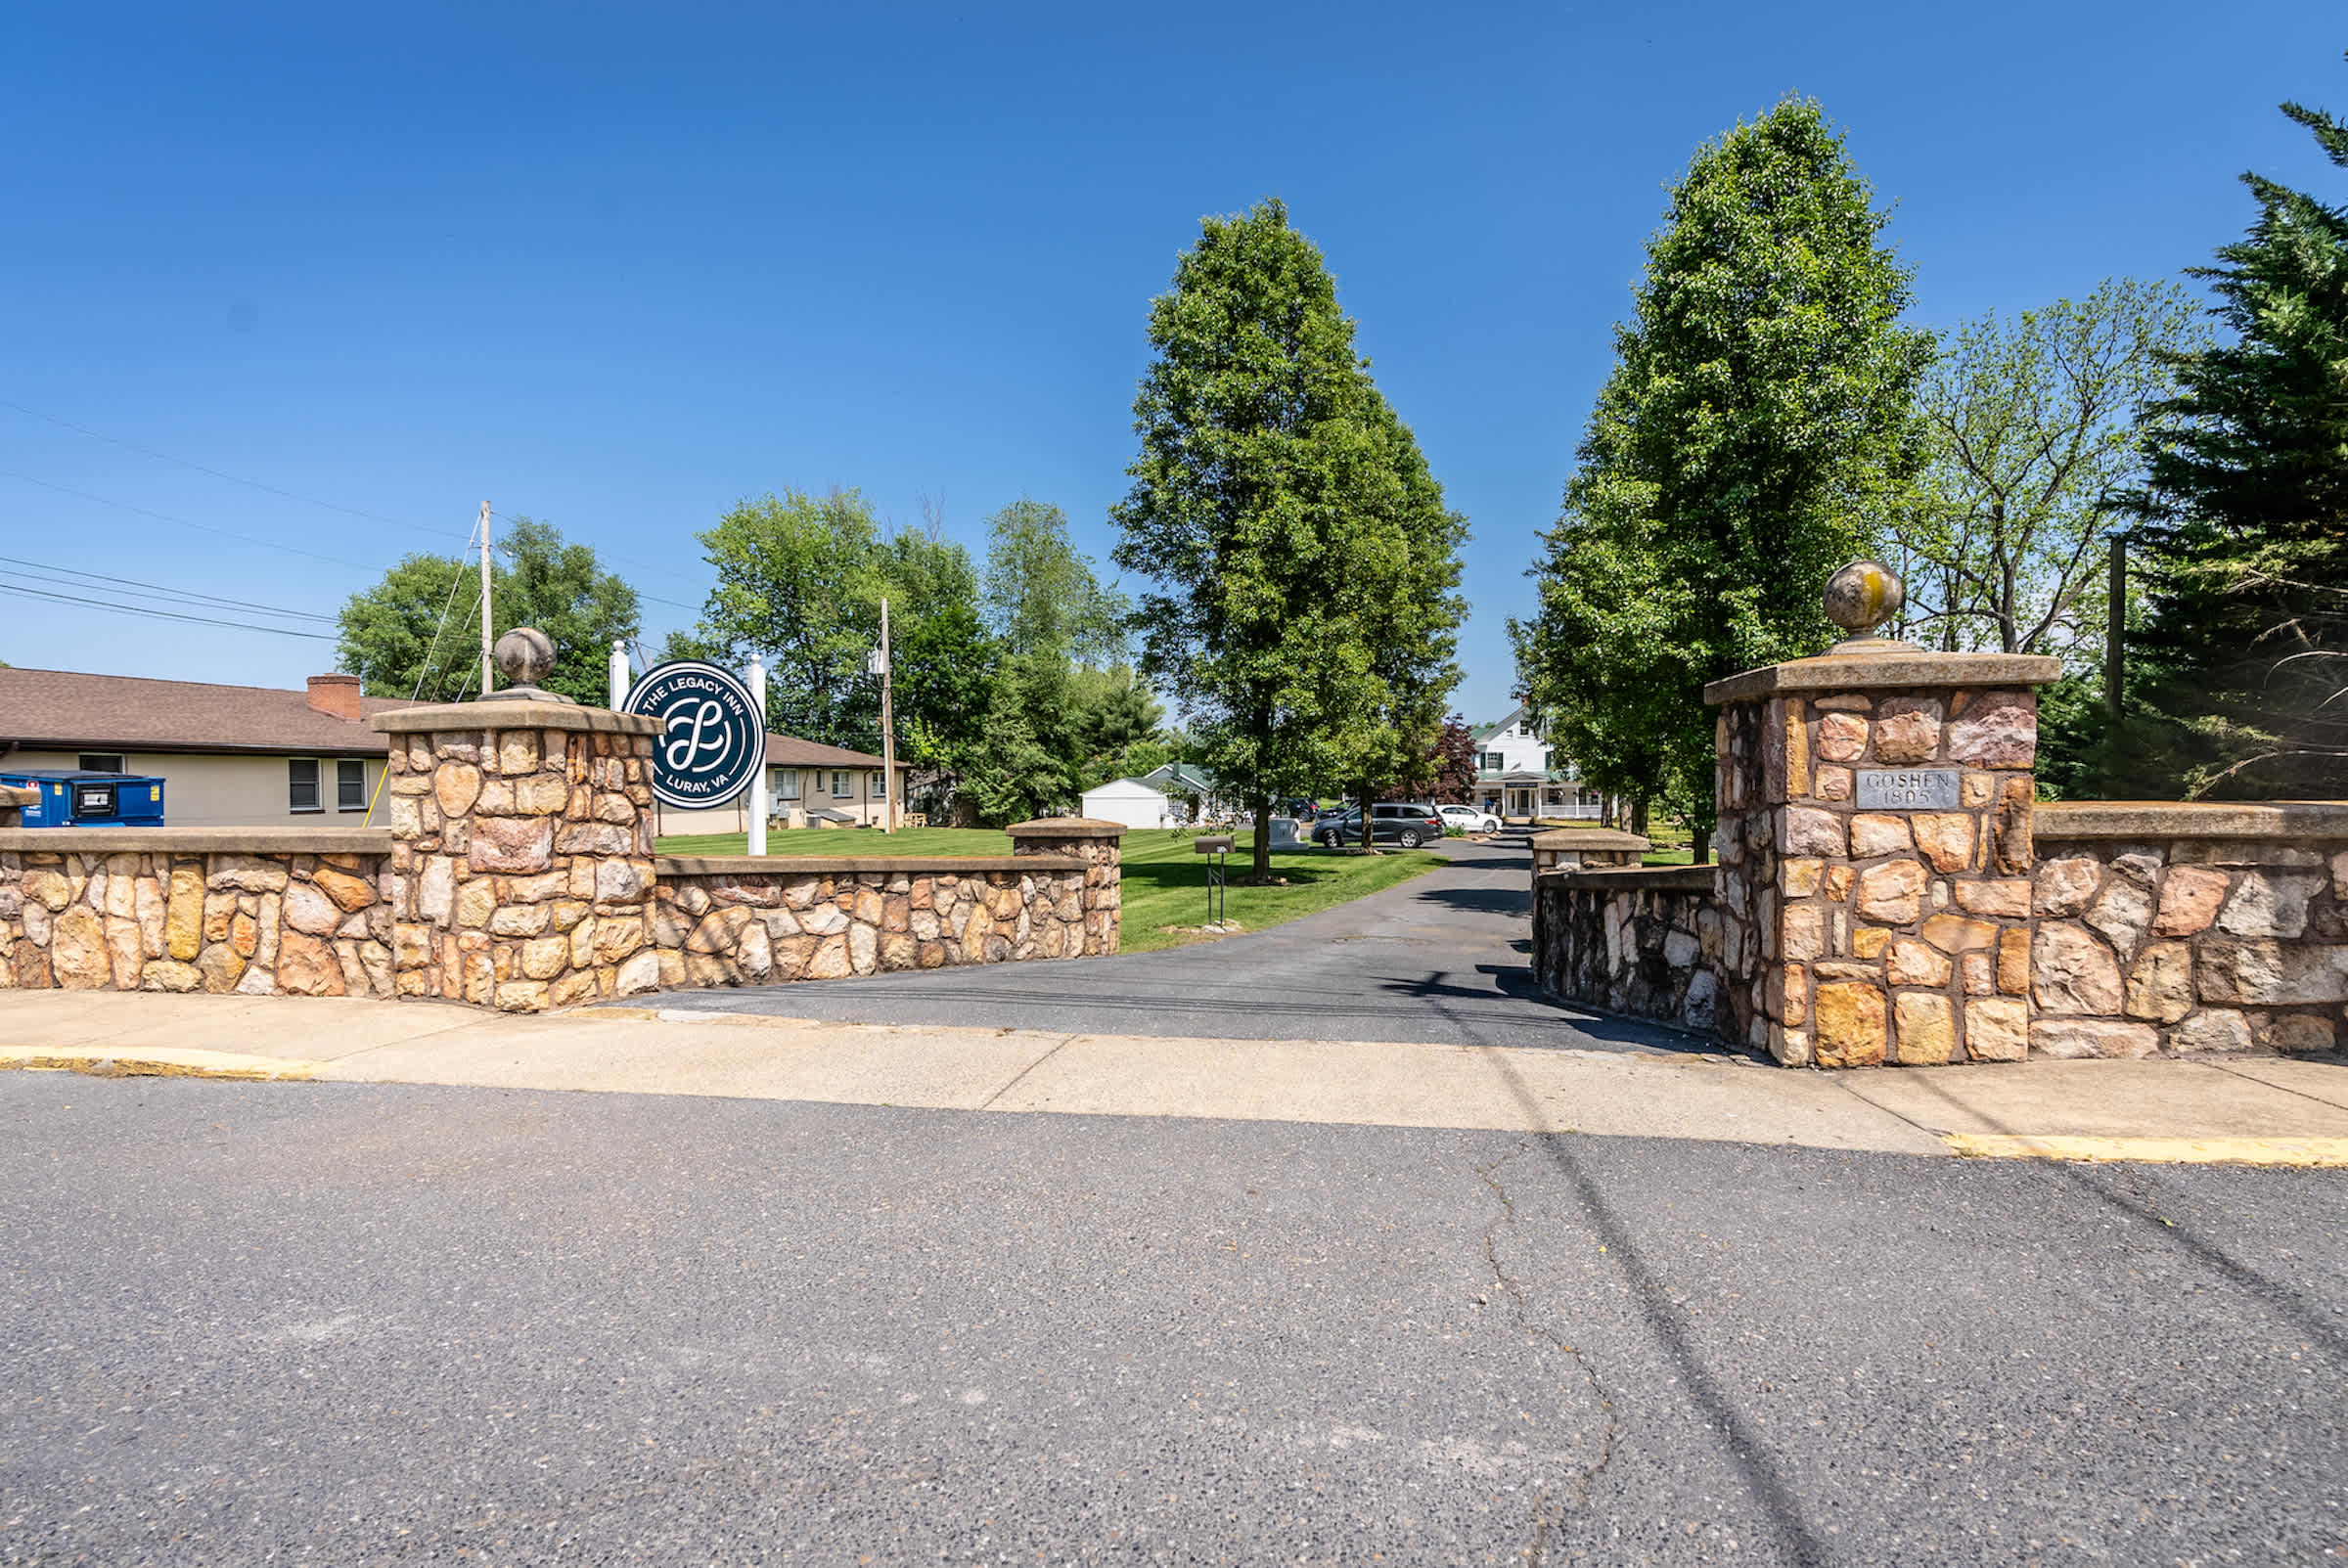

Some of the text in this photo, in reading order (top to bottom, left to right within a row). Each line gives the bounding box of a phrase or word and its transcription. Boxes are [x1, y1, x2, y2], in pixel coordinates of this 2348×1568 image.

[642, 677, 745, 716] THE LEGACY INN
[666, 774, 729, 793] LURAY, VA
[1867, 774, 1950, 788] GOSHEN
